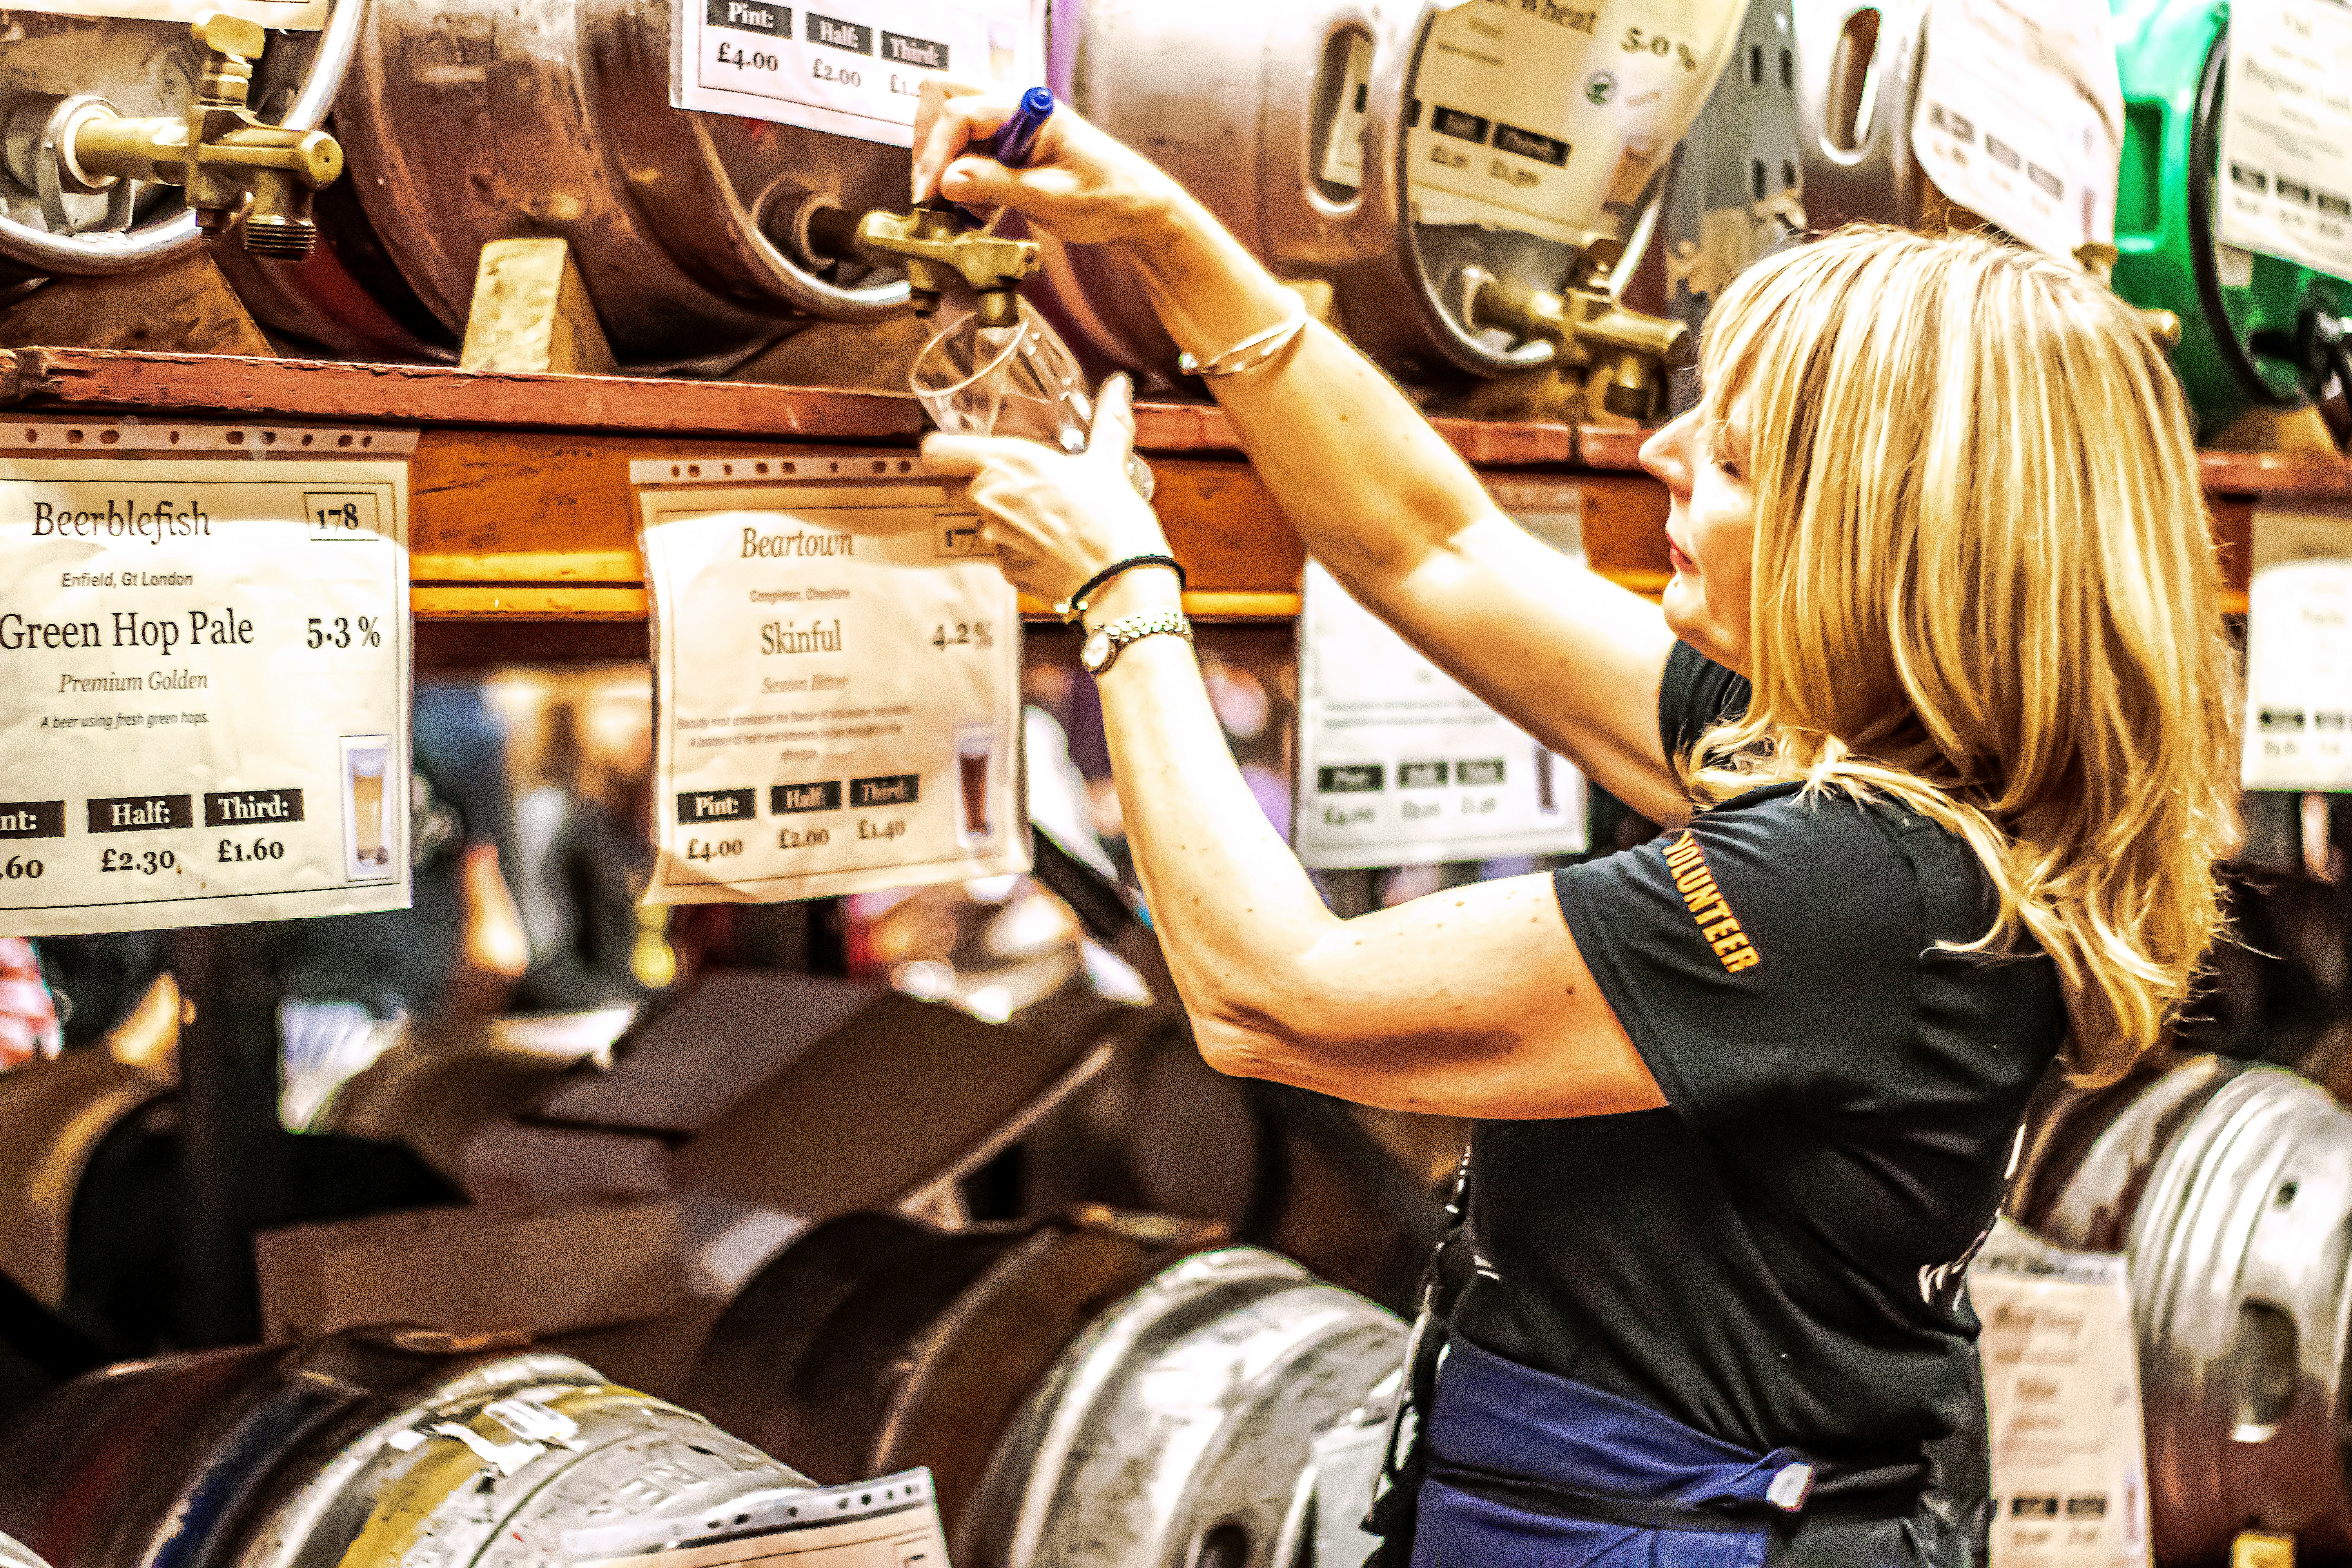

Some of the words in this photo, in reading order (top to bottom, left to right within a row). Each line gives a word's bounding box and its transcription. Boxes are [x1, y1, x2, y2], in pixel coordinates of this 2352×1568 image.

[728, 1, 774, 29] Pint:
[820, 21, 858, 48] Half:
[890, 37, 940, 67] Third:
[717, 43, 778, 71] £4.00
[812, 58, 861, 87] £2.00
[32, 500, 211, 545] Beerblefish
[316, 503, 359, 530] 178
[740, 527, 853, 558] Beartown
[946, 519, 985, 552] 17
[62, 572, 116, 589] Enfield,
[121, 572, 138, 587] Gt
[141, 572, 194, 586] London
[0, 613, 101, 650] Green
[112, 612, 179, 655] Hop
[189, 608, 254, 645] Pale
[761, 619, 842, 655] Skinful
[59, 671, 143, 693] Premium
[148, 669, 208, 690] Golden
[111, 800, 171, 826] Half:
[218, 794, 289, 820] Third:
[696, 795, 738, 817] Pint:
[787, 788, 825, 808] Half:
[100, 848, 175, 875] £2.30
[219, 837, 285, 863] £1.60
[687, 838, 743, 863] £4.00
[779, 829, 830, 849] £2.00
[859, 818, 906, 841] £1.40
[1662, 830, 1760, 973] VOLUNTEER
